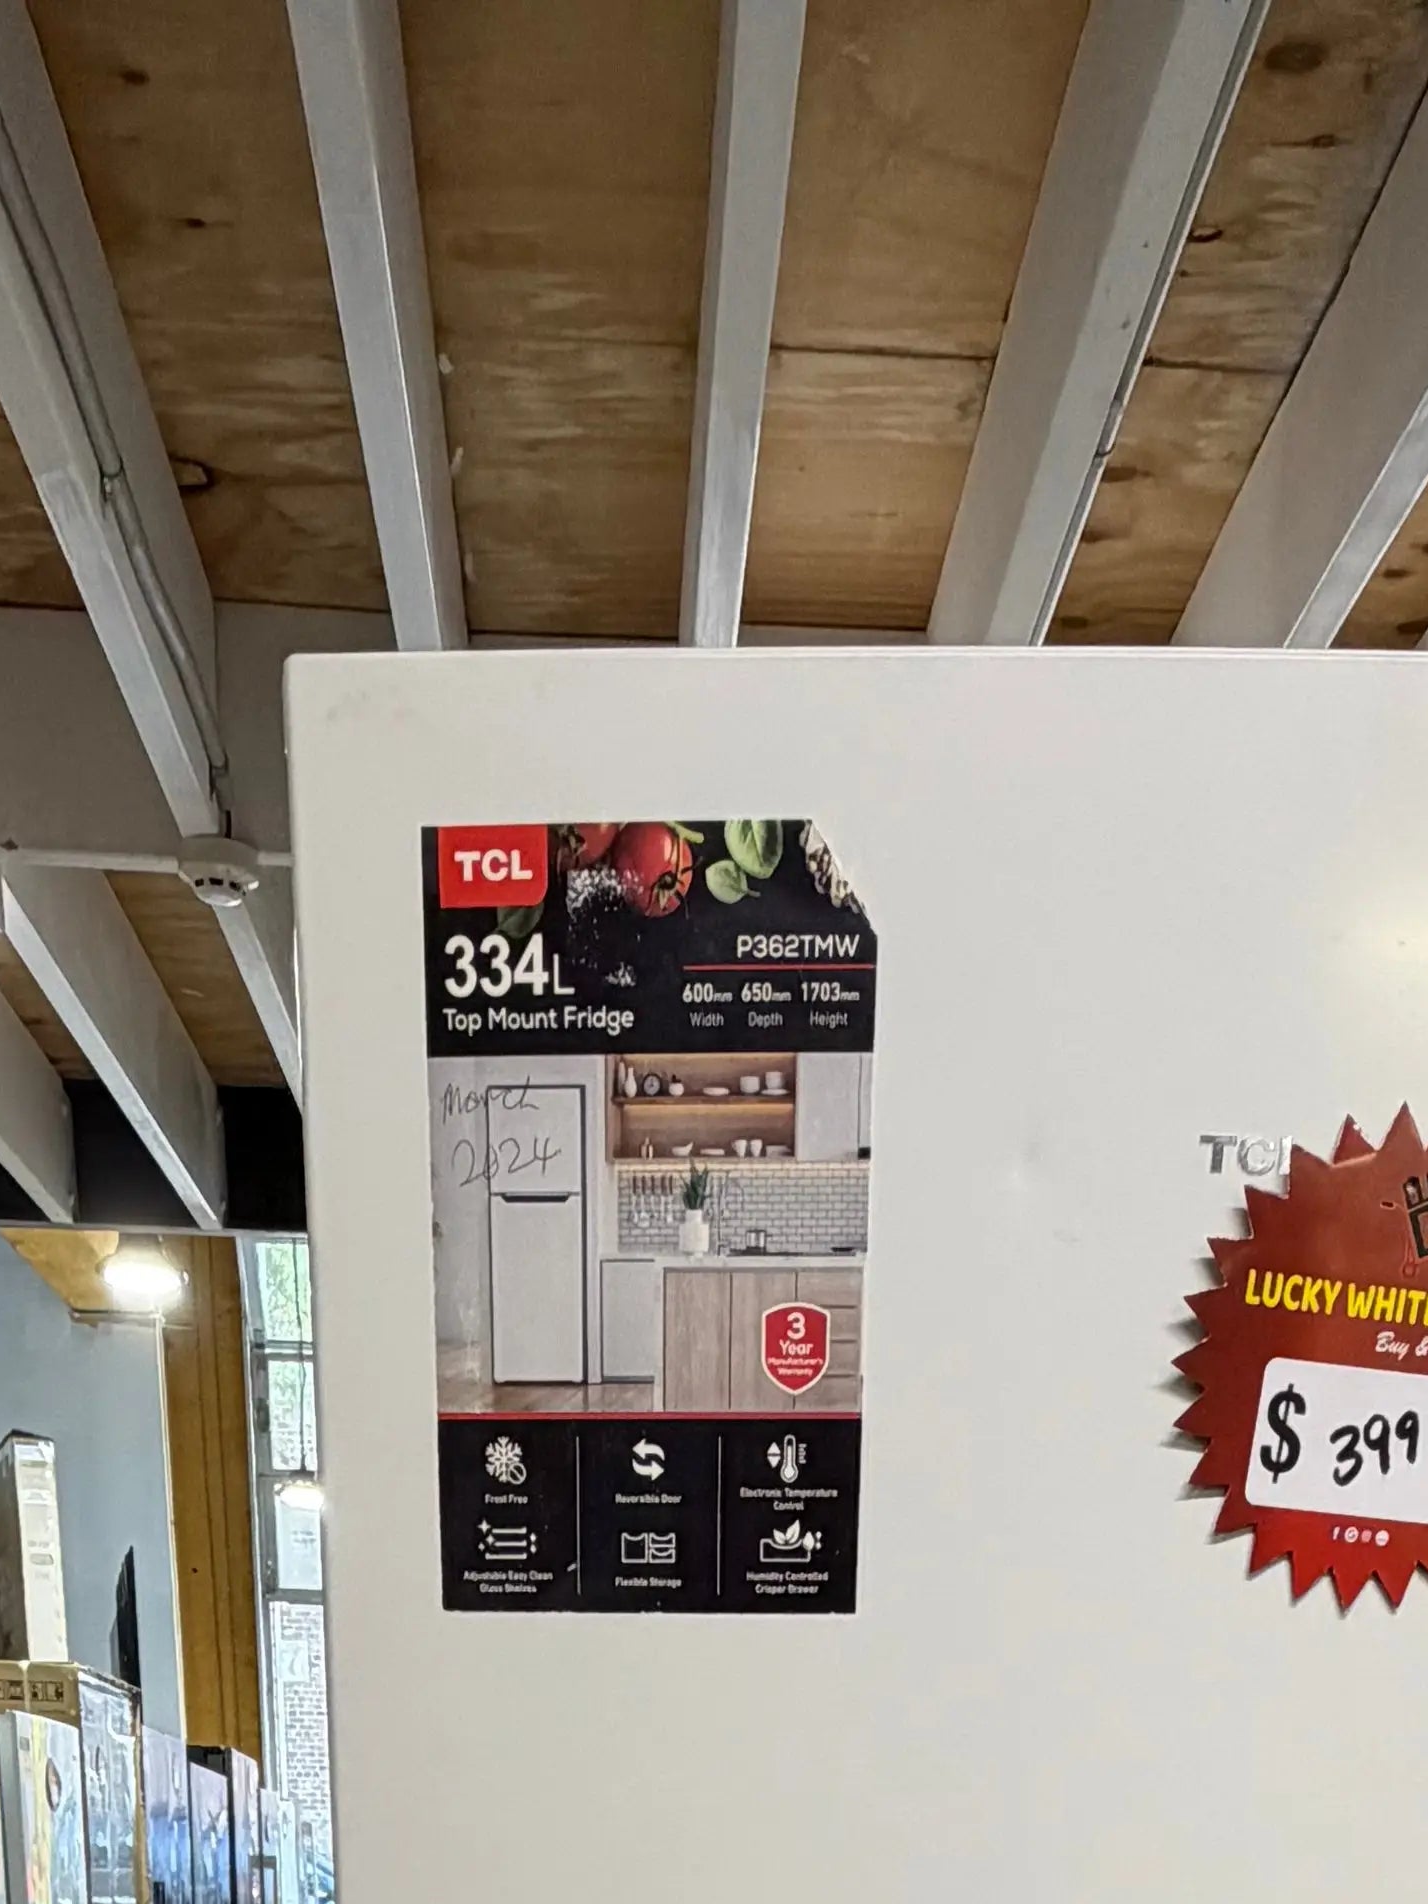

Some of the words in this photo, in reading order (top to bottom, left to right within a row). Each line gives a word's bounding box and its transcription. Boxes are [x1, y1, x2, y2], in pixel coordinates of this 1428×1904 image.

[454, 848, 533, 882] TCL
[736, 934, 860, 959] P362TMW
[443, 933, 576, 998] 334L
[442, 1007, 482, 1036] Top
[488, 1007, 558, 1031] Mount
[564, 1005, 635, 1036] Fridge
[689, 1011, 725, 1027] Width
[748, 1010, 784, 1029] Depth
[809, 1010, 849, 1029] Height
[452, 1137, 562, 1188] 2024
[1244, 1268, 1341, 1317] LUCKY
[787, 1312, 806, 1340] 3
[779, 1339, 814, 1356] Year
[1375, 1331, 1410, 1361] Buy
[1259, 1383, 1307, 1483] $
[1329, 1410, 1421, 1487] 399
